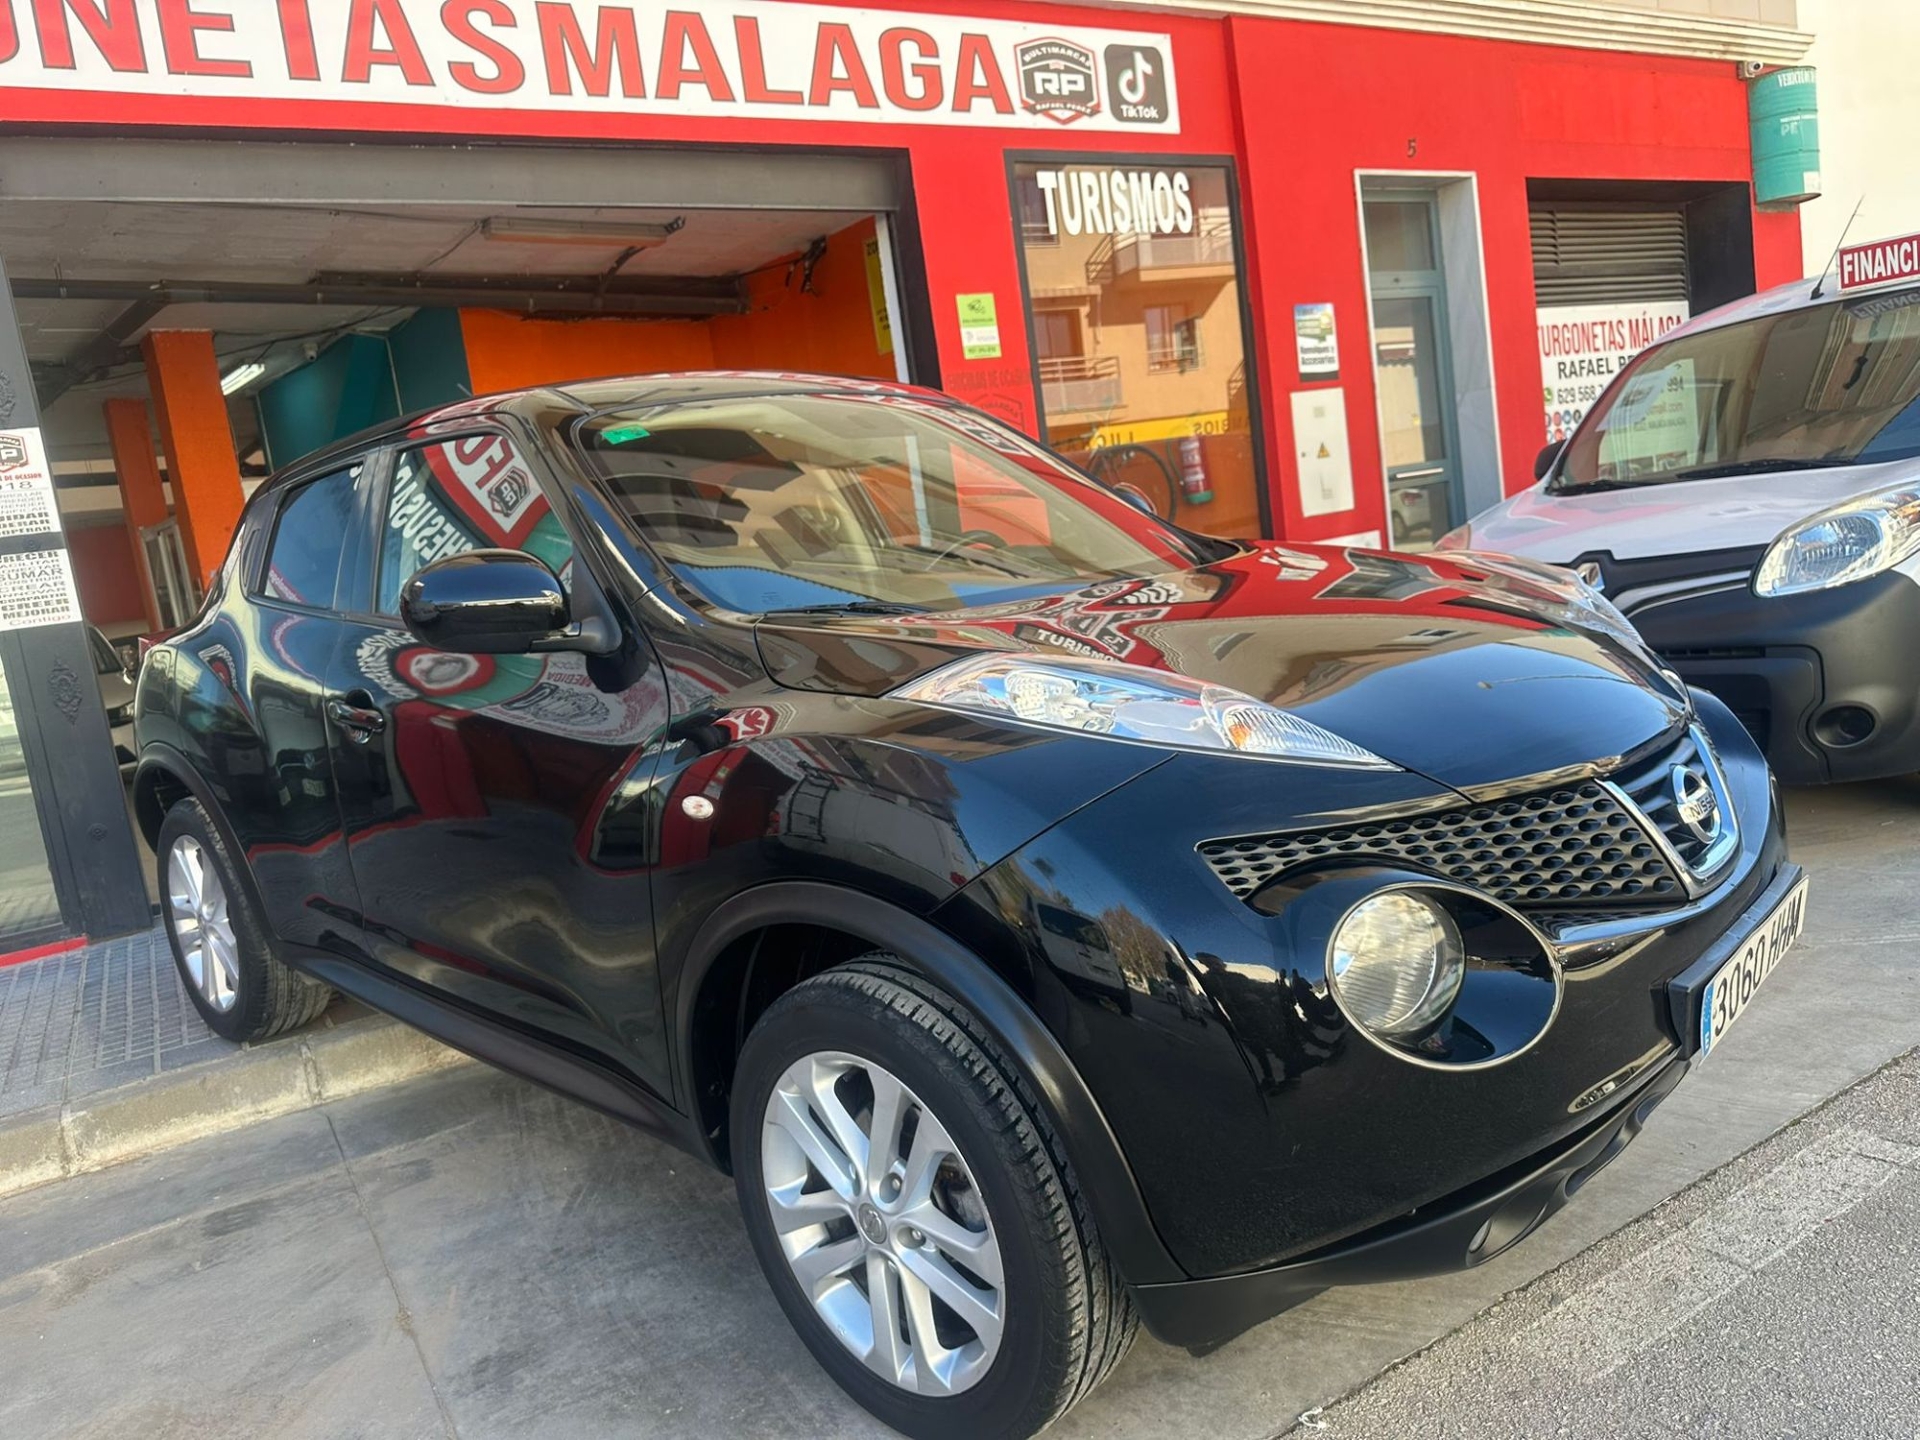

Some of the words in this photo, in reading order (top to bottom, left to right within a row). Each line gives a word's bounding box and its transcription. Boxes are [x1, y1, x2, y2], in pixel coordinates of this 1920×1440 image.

[1033, 71, 1086, 96] RP
[1120, 104, 1159, 119] TikTok
[1406, 138, 1417, 159] 5
[1035, 169, 1193, 236] TURISMOS
[1842, 239, 1920, 285] FINANCI
[1537, 319, 1626, 357] URGONETAS
[1558, 357, 1614, 380] RAFAEL
[2, 605, 71, 621] MEJORAR
[9, 614, 71, 626] Contigo
[1714, 934, 1766, 1037] 3060
[1766, 889, 1803, 973] HHM
